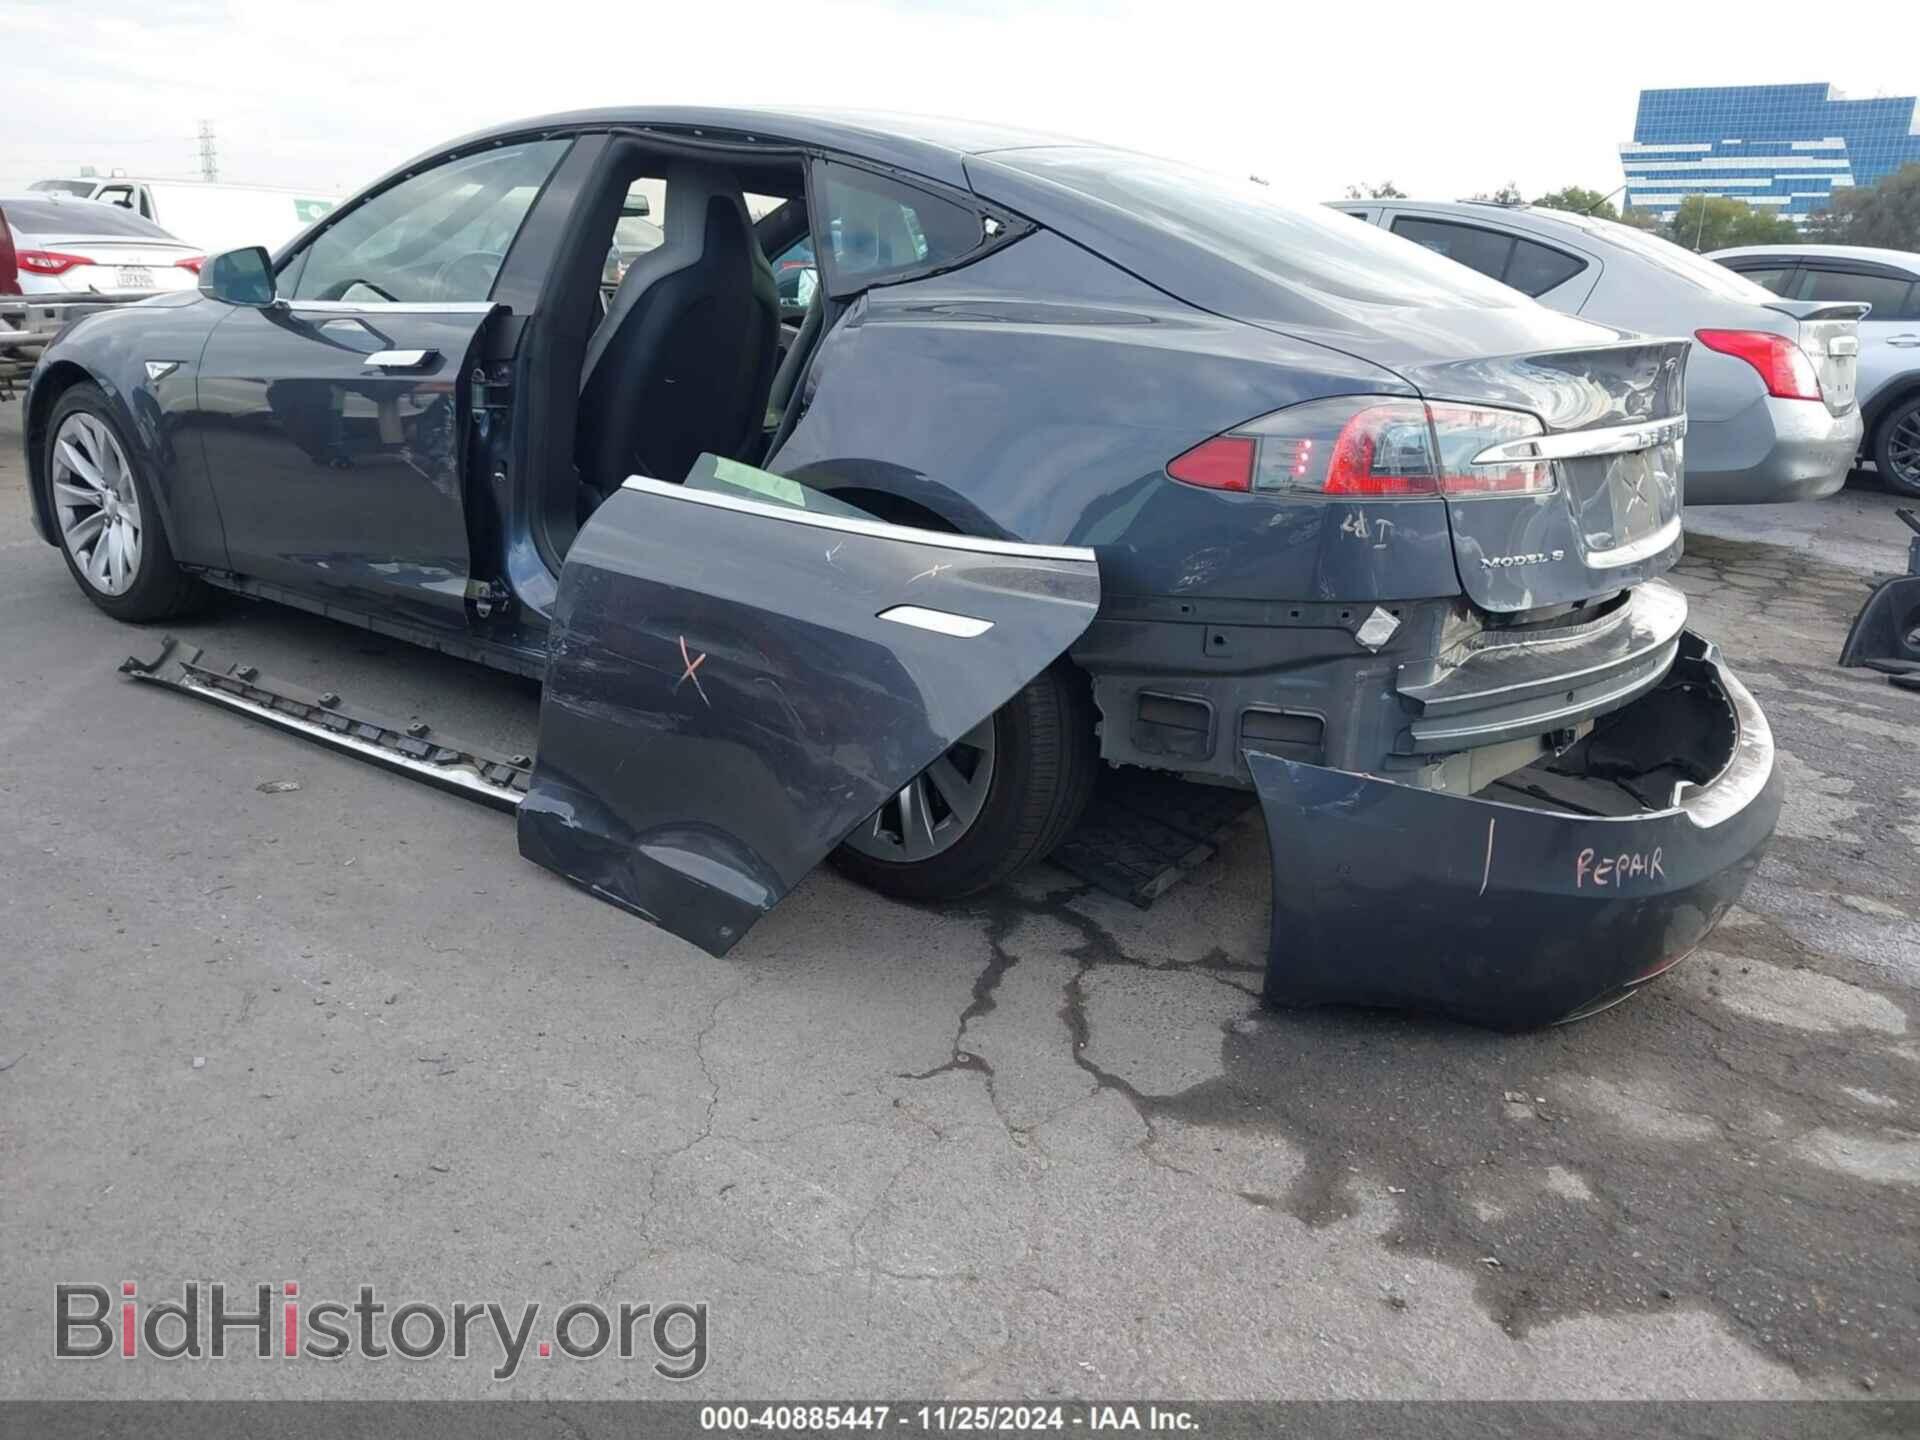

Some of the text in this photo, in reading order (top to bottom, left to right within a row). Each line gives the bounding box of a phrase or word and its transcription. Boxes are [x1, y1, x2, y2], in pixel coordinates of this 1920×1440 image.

[1480, 549, 1565, 569] MODEL S
[1576, 847, 1664, 888] REPAIR
